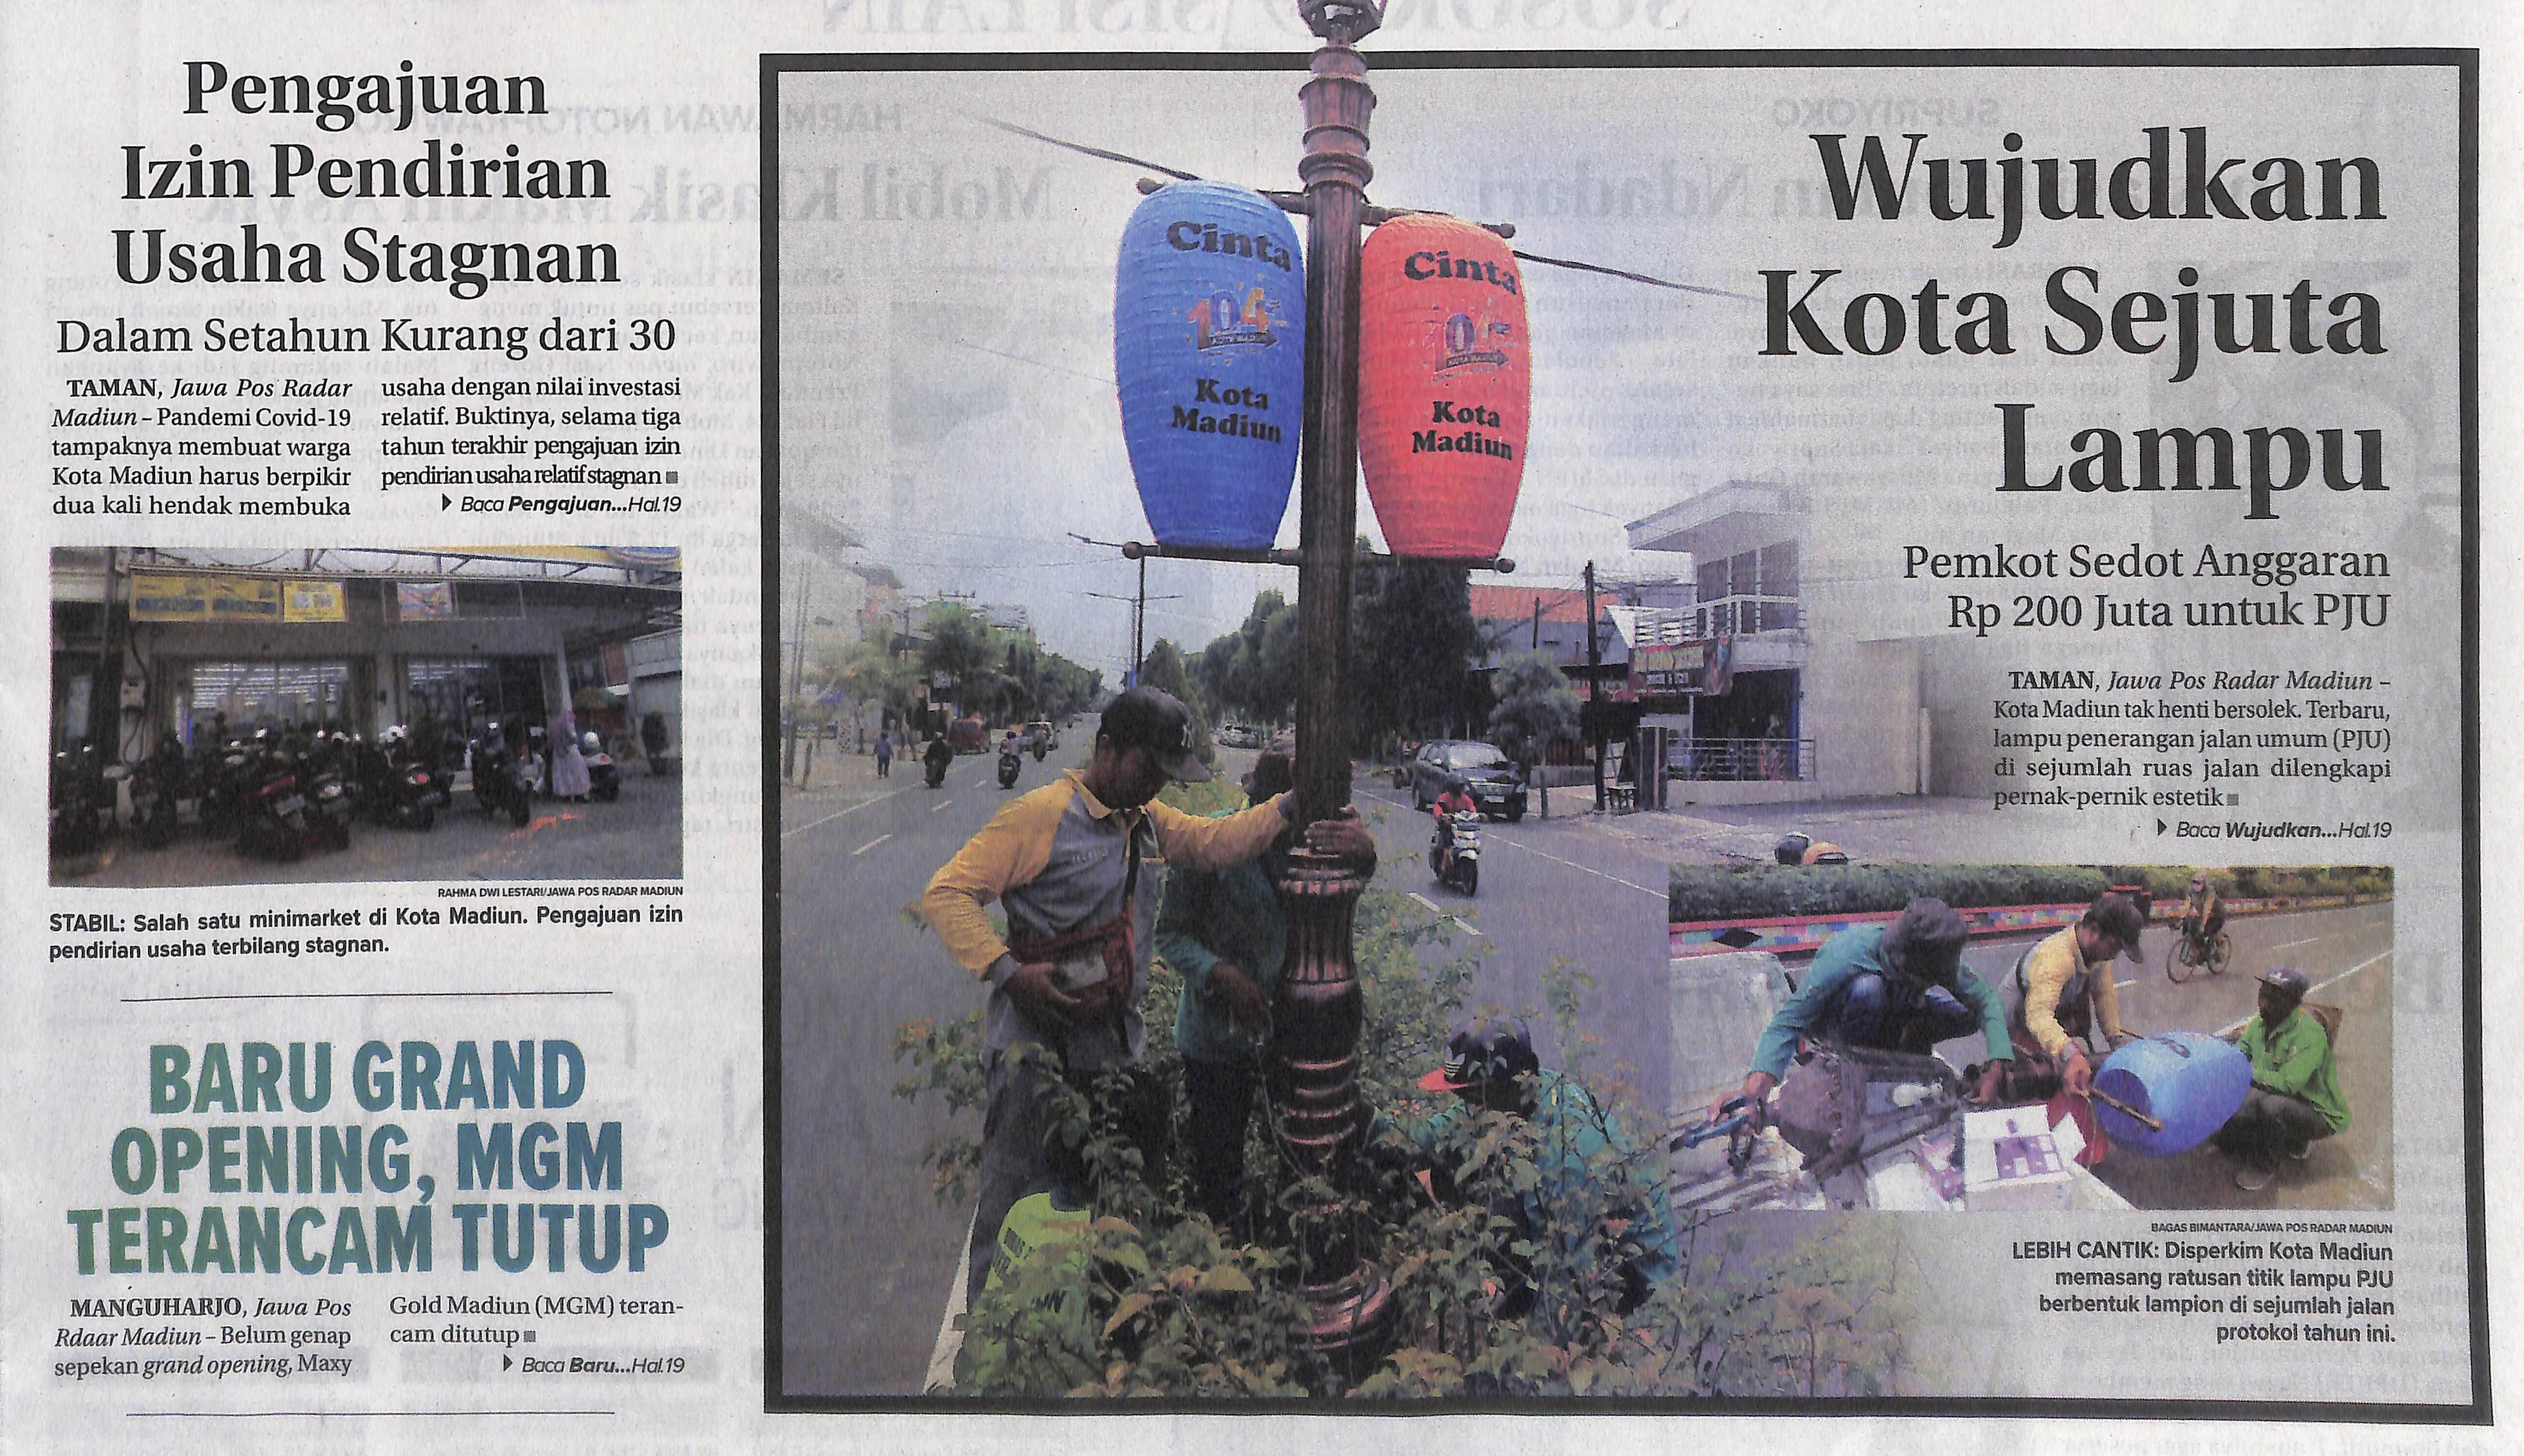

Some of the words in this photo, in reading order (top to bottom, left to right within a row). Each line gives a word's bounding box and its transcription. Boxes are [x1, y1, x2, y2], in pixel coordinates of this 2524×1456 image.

[183, 60, 548, 131] Pengajuan
[121, 144, 253, 199] Izin
[270, 139, 610, 199] Pendirian
[1809, 126, 2387, 249] Wujudkan
[1167, 220, 1291, 273] Cinta
[111, 224, 326, 284] Usaha
[343, 228, 621, 299] Stagnan
[1404, 251, 1517, 294] Cinta
[1758, 270, 2016, 355] Kota
[2045, 266, 2388, 383] Sejuta
[57, 318, 193, 353] Dalam
[204, 318, 370, 352] Setahun
[381, 319, 528, 360] Kurang
[540, 316, 618, 351] dari
[630, 319, 675, 351] 30
[67, 379, 162, 399] TAMAN,
[170, 379, 227, 399] Jawa
[236, 379, 274, 397] Pos
[282, 378, 353, 397] Radar
[381, 378, 445, 396] usaha
[451, 377, 531, 401] dengan
[536, 376, 583, 395] nilai
[588, 378, 680, 396] investasi
[1195, 378, 1269, 410] Kota
[51, 407, 137, 427] Madiun
[157, 407, 251, 426] Pandemi
[256, 408, 350, 426] Covid-19
[381, 406, 448, 426] relatif.
[455, 406, 555, 430] Buktinya,
[561, 406, 636, 425] selama
[642, 408, 681, 431] tiga
[1172, 404, 1281, 443] Madiun
[1432, 401, 1501, 428] Kota
[52, 436, 172, 461] tampaknya
[178, 436, 281, 456] membuat
[286, 443, 351, 461] warga
[381, 436, 445, 455] tahun
[451, 435, 528, 454] terakhir
[534, 436, 638, 459] pengajuan
[645, 436, 681, 454] izin
[1412, 429, 1512, 461] Madiun
[1994, 404, 2390, 520] Lampu
[53, 467, 102, 485] Kota
[109, 465, 193, 484] Madiun
[199, 466, 259, 485] harus
[266, 466, 351, 491] berpikir
[381, 466, 473, 491] pendirian
[476, 464, 532, 484] usaha
[534, 464, 587, 483] relatif
[588, 468, 662, 490] stagnan
[53, 496, 95, 514] dua
[103, 495, 142, 513] kali
[149, 495, 233, 515] hendak
[239, 496, 351, 515] membuka
[461, 496, 504, 511] Baca
[1903, 544, 2058, 578] Pemkot
[2070, 543, 2184, 577] Sedot
[2193, 545, 2390, 586] Anggaran
[1948, 596, 2000, 637] Rp
[2013, 596, 2081, 626] 200
[2093, 595, 2173, 631] Juta
[2184, 591, 2304, 626] untuk
[2314, 594, 2391, 630] PJU
[2008, 671, 2099, 692] TAMAN,
[2107, 671, 2161, 691] Jawa
[2169, 671, 2206, 690] Pos
[2213, 670, 2280, 690] Radar
[2285, 671, 2372, 690] Madiun
[1993, 701, 2038, 718] Kota
[2043, 699, 2120, 718] Madiun
[2124, 700, 2154, 718] tak
[2158, 700, 2210, 718] henti
[2213, 699, 2301, 718] bersolek.
[2306, 700, 2390, 721] Terbaru,
[1993, 728, 2062, 752] lampu
[2066, 733, 2195, 753] penerangan
[2198, 729, 2252, 753] jalan
[2256, 734, 2327, 747] umum
[2333, 728, 2390, 753] (PJU)
[1994, 759, 2015, 777] di
[2026, 757, 2131, 781] sejumlah
[2143, 763, 2192, 776] ruas
[2203, 758, 2259, 782] jalan
[2271, 758, 2391, 783] dilengkapi
[1994, 787, 2148, 810] pernak-pernik
[2153, 788, 2224, 806] estetik
[2176, 821, 2220, 838] Baca
[438, 888, 476, 897] RAHMA
[480, 888, 500, 896] DWI
[578, 887, 599, 896] POS
[602, 887, 638, 896] RADAR
[641, 886, 683, 895] MADIUN
[50, 913, 125, 931] STABIL:
[134, 913, 188, 931] Salah
[198, 913, 239, 930] satu
[250, 909, 361, 928] minimarket
[370, 908, 386, 925] di
[397, 908, 440, 925] Kota
[450, 906, 527, 924] Madiun.
[538, 905, 640, 927] Pengajuan
[650, 905, 682, 922] izin
[50, 941, 141, 963] pendirian
[148, 940, 206, 958] usaha
[212, 936, 299, 957] terbilang
[306, 937, 389, 957] stagnan.
[150, 1042, 331, 1114] BARU
[353, 1038, 585, 1112] GRAND
[110, 1124, 435, 1204] OPENING,
[456, 1120, 622, 1191] MGM
[67, 1205, 432, 1275] TERANCAM
[452, 1203, 668, 1273] TUTUP
[2151, 1223, 2187, 1232] BAGAS
[2286, 1223, 2308, 1232] POS
[2310, 1223, 2346, 1233] RADAR
[2350, 1224, 2392, 1233] MADIUN
[2013, 1242, 2070, 1259] LEBIH
[2078, 1241, 2159, 1258] CANTIK:
[2166, 1241, 2263, 1263] Disperkim
[2270, 1242, 2313, 1259] Kota
[2320, 1242, 2392, 1260] Madiun
[2056, 1272, 2161, 1290] memasang
[2169, 1270, 2241, 1286] ratusan
[2247, 1268, 2284, 1286] titik
[2291, 1269, 2350, 1291] lampu
[2358, 1270, 2393, 1288] PJU
[70, 1297, 247, 1318] MANGUHARJO,
[253, 1298, 308, 1317] Jawa
[315, 1298, 351, 1316] Pos
[390, 1295, 442, 1314] Gold
[447, 1296, 530, 1314] Madiun
[536, 1295, 614, 1318] (MGM)
[619, 1299, 683, 1314] teran-
[2040, 1294, 2139, 1312] berbentuk
[2146, 1294, 2223, 1316] lampion
[2230, 1295, 2246, 1313] di
[2253, 1295, 2341, 1317] sejumlah
[2346, 1296, 2394, 1318] jalan
[54, 1328, 118, 1347] Rdaar
[121, 1327, 201, 1345] Madiun
[221, 1325, 286, 1344] Belum
[291, 1330, 350, 1348] genap
[391, 1329, 435, 1342] cam
[441, 1324, 519, 1348] ditutup
[2217, 1323, 2298, 1343] protokol
[2303, 1323, 2360, 1342] tahun
[2367, 1323, 2395, 1342] ini.
[55, 1356, 139, 1380] sepekan
[143, 1355, 203, 1379] grand
[208, 1355, 292, 1379] opening,
[298, 1354, 352, 1377] Maxy
[522, 1357, 565, 1372] Baca
